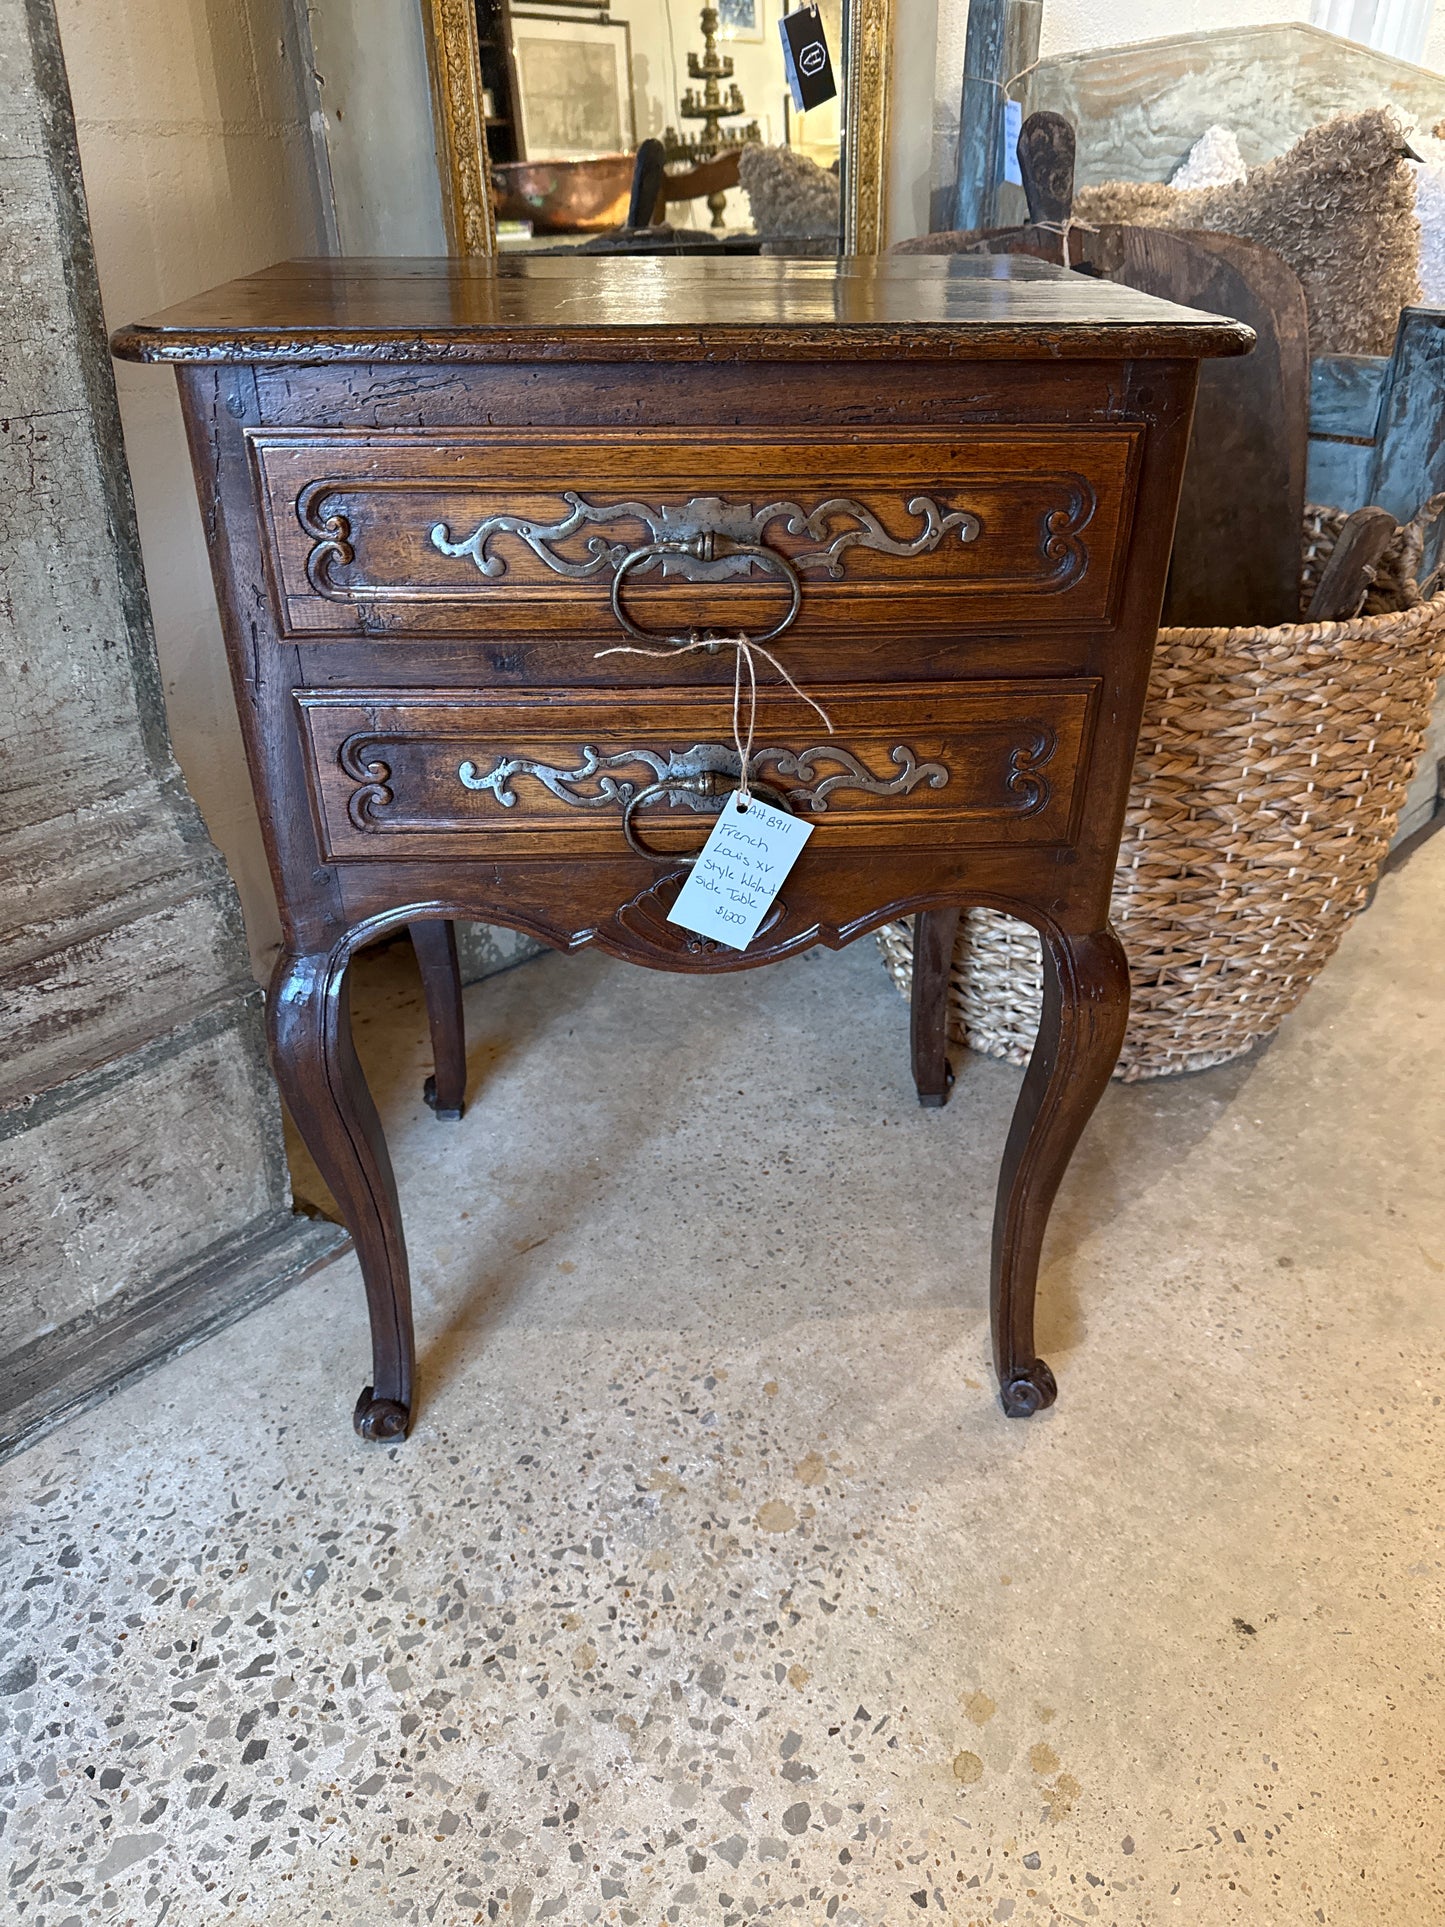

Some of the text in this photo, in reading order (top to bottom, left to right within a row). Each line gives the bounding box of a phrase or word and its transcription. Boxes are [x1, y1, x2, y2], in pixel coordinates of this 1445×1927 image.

[747, 805, 791, 833] AH 8911
[720, 823, 768, 852] French
[714, 843, 749, 866] Louis
[741, 872, 776, 896] Walnut
[727, 888, 757, 908] Table
[716, 906, 746, 924] $1200
